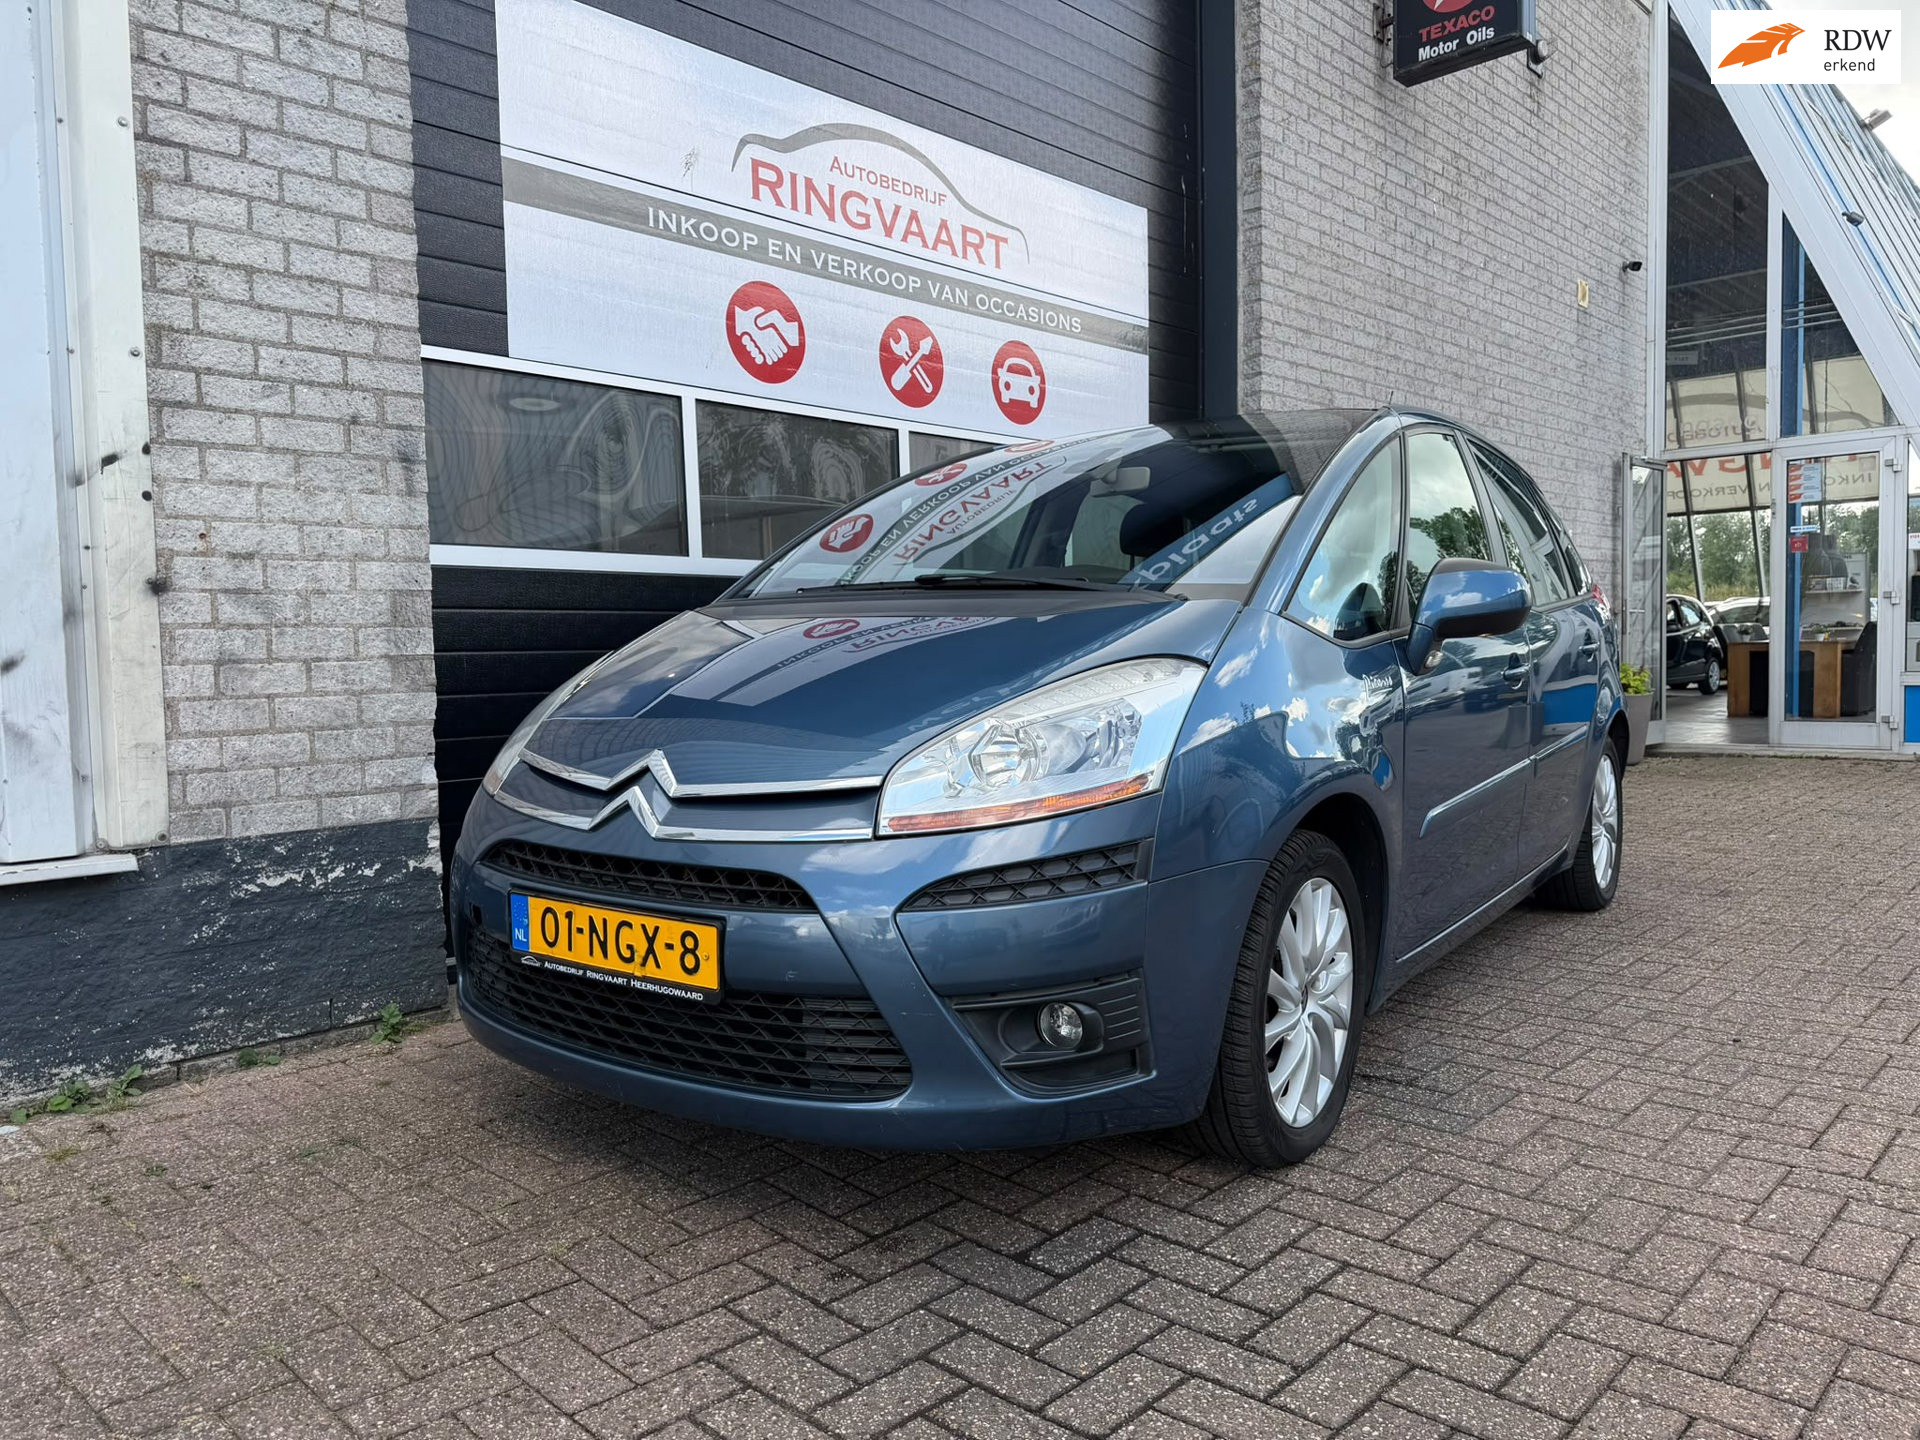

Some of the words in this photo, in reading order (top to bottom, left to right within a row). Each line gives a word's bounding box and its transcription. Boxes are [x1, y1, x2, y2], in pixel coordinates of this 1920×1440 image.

[1418, 5, 1496, 43] TEXACO
[1418, 38, 1460, 62] Motor
[1466, 26, 1495, 45] Oils
[829, 156, 947, 208] AUTOBEDRIJF
[750, 157, 1008, 269] RINGVAART
[648, 207, 758, 251] INKOOP
[768, 238, 801, 264] EN
[810, 249, 921, 293] VERKOOP
[927, 280, 968, 306] VAN
[976, 293, 1082, 333] OCCASIONS
[515, 928, 528, 942] NL
[541, 906, 700, 976] 01-NGX-8
[544, 961, 585, 976] AUTOBEDRIJF
[586, 970, 628, 986] RINGVAART
[630, 978, 704, 1001] HEERHUGOWAARD
